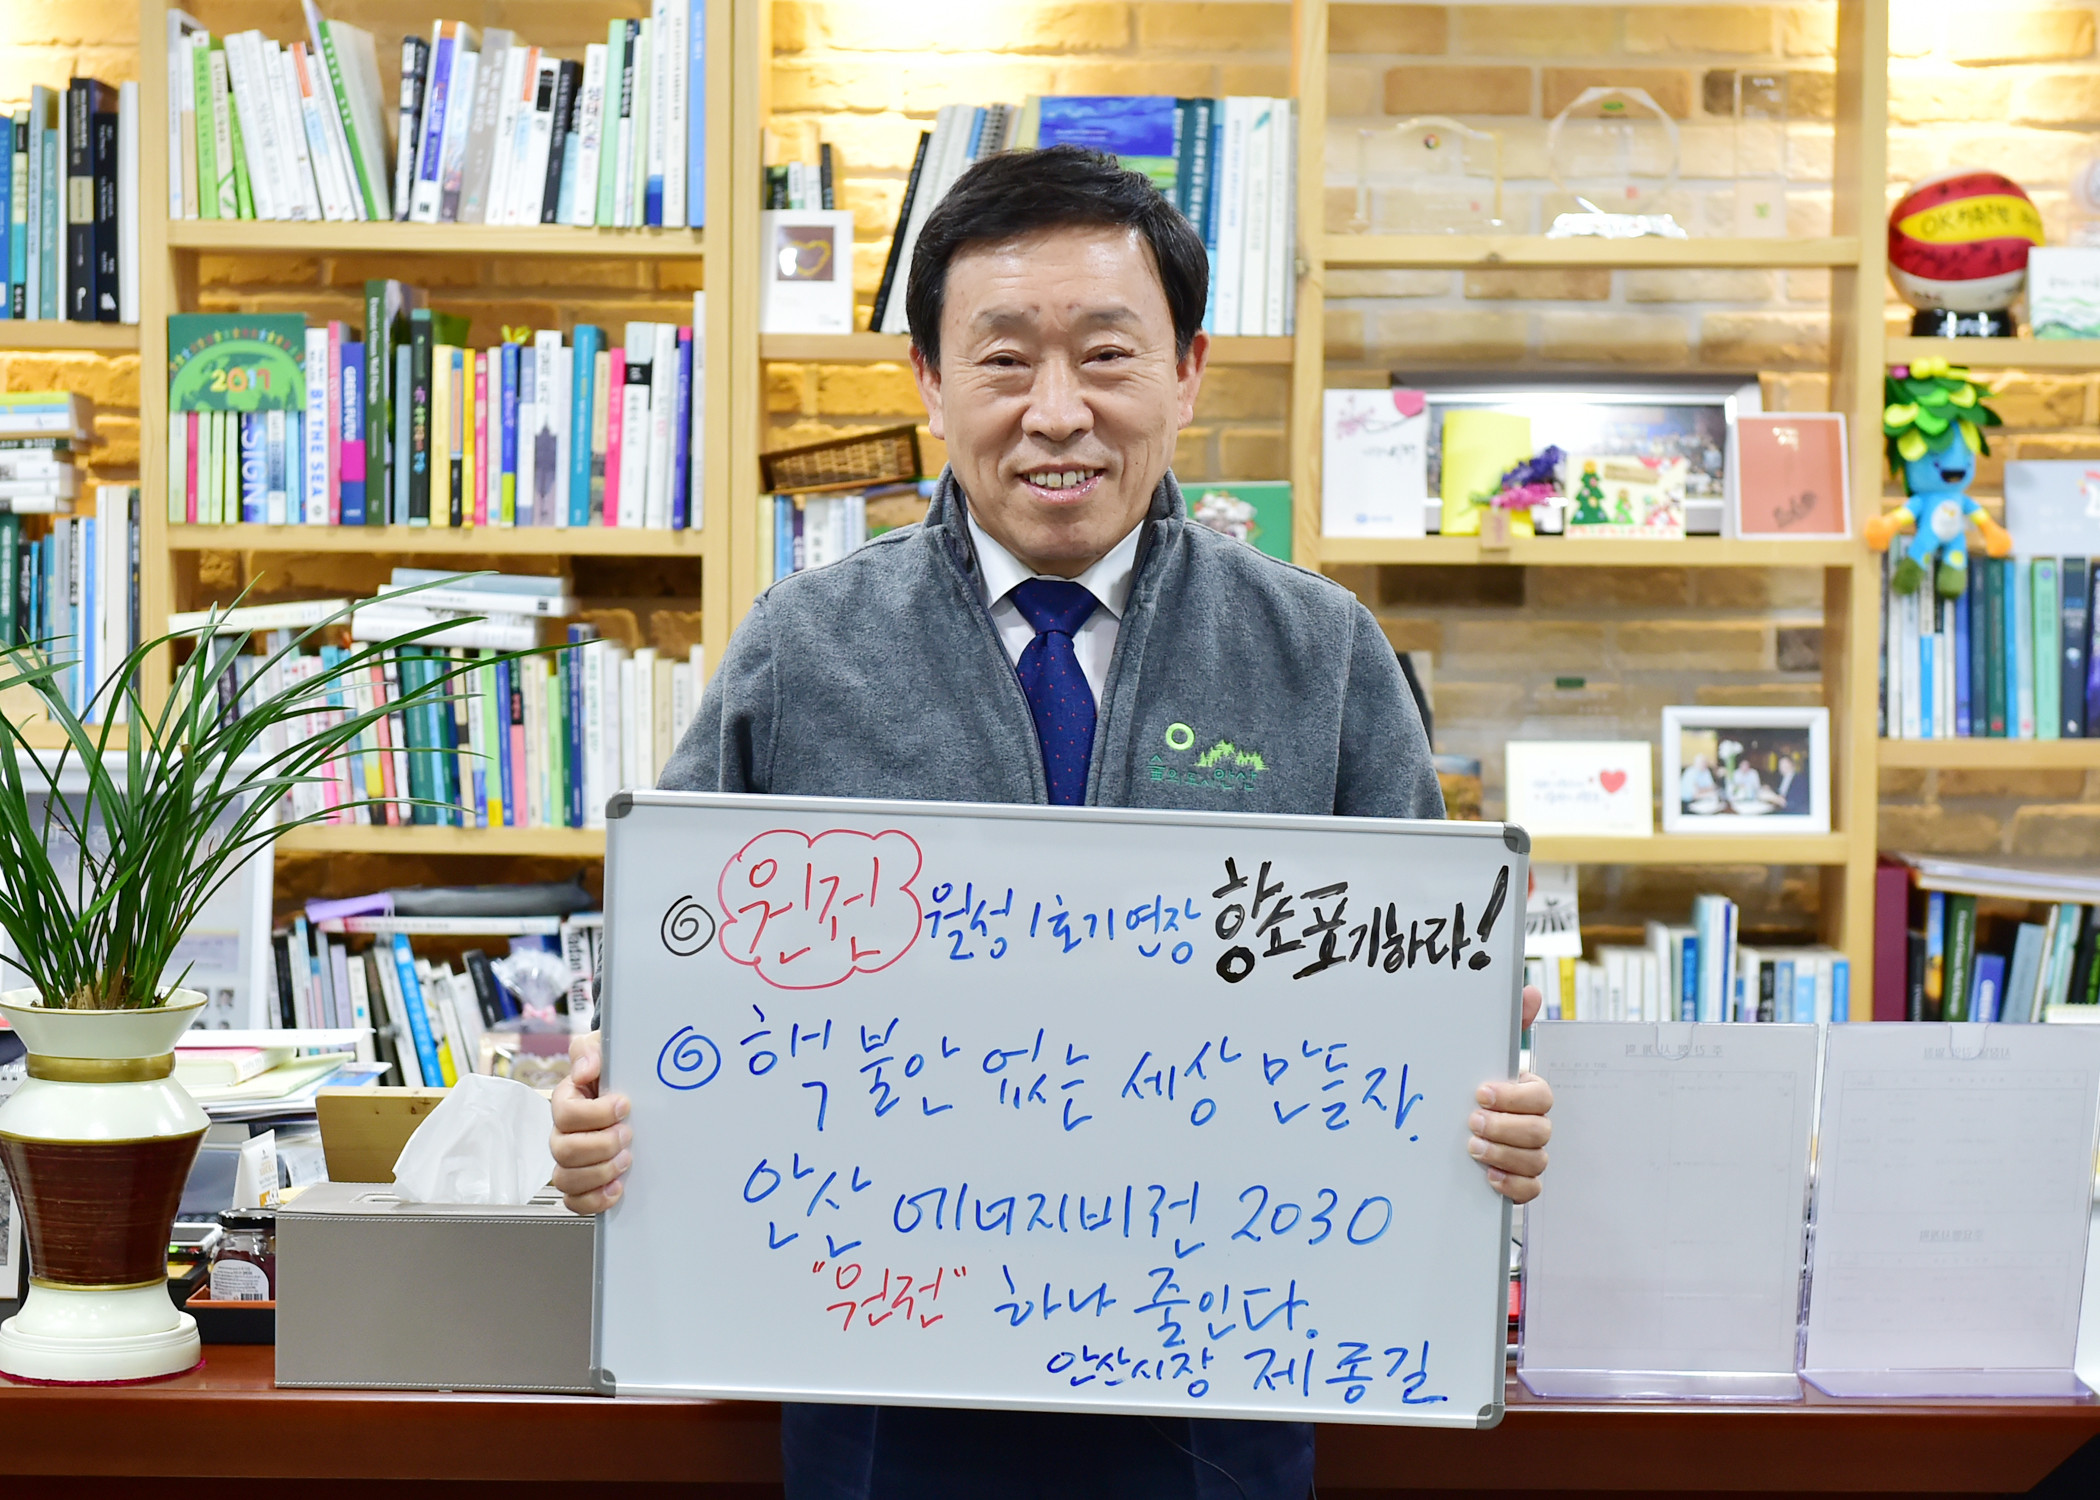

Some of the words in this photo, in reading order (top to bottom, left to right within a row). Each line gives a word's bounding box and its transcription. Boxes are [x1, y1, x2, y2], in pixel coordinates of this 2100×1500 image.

[209, 367, 271, 394] 2017
[310, 388, 324, 409] BY
[344, 366, 357, 406] GREEN
[310, 420, 324, 452] THE
[344, 408, 357, 441] FUTU
[310, 462, 324, 497] SEA
[738, 856, 880, 965] 원전
[924, 882, 1014, 960] 월성
[1030, 894, 1115, 954] 1호기
[1125, 894, 1202, 965] 연장
[740, 1004, 833, 1132] 핵
[859, 1017, 961, 1118] 불안
[982, 1028, 1094, 1132] 없는
[1120, 1036, 1243, 1127] 세상
[1263, 1040, 1425, 1143] 만들자.
[743, 1153, 873, 1259] 안산
[893, 1180, 1206, 1260] 에너지비전
[1231, 1184, 1393, 1246] 2030
[993, 1263, 1118, 1328] 하나
[1133, 1266, 1320, 1348] 줄인다.
[1046, 1345, 1214, 1398] 안산시장
